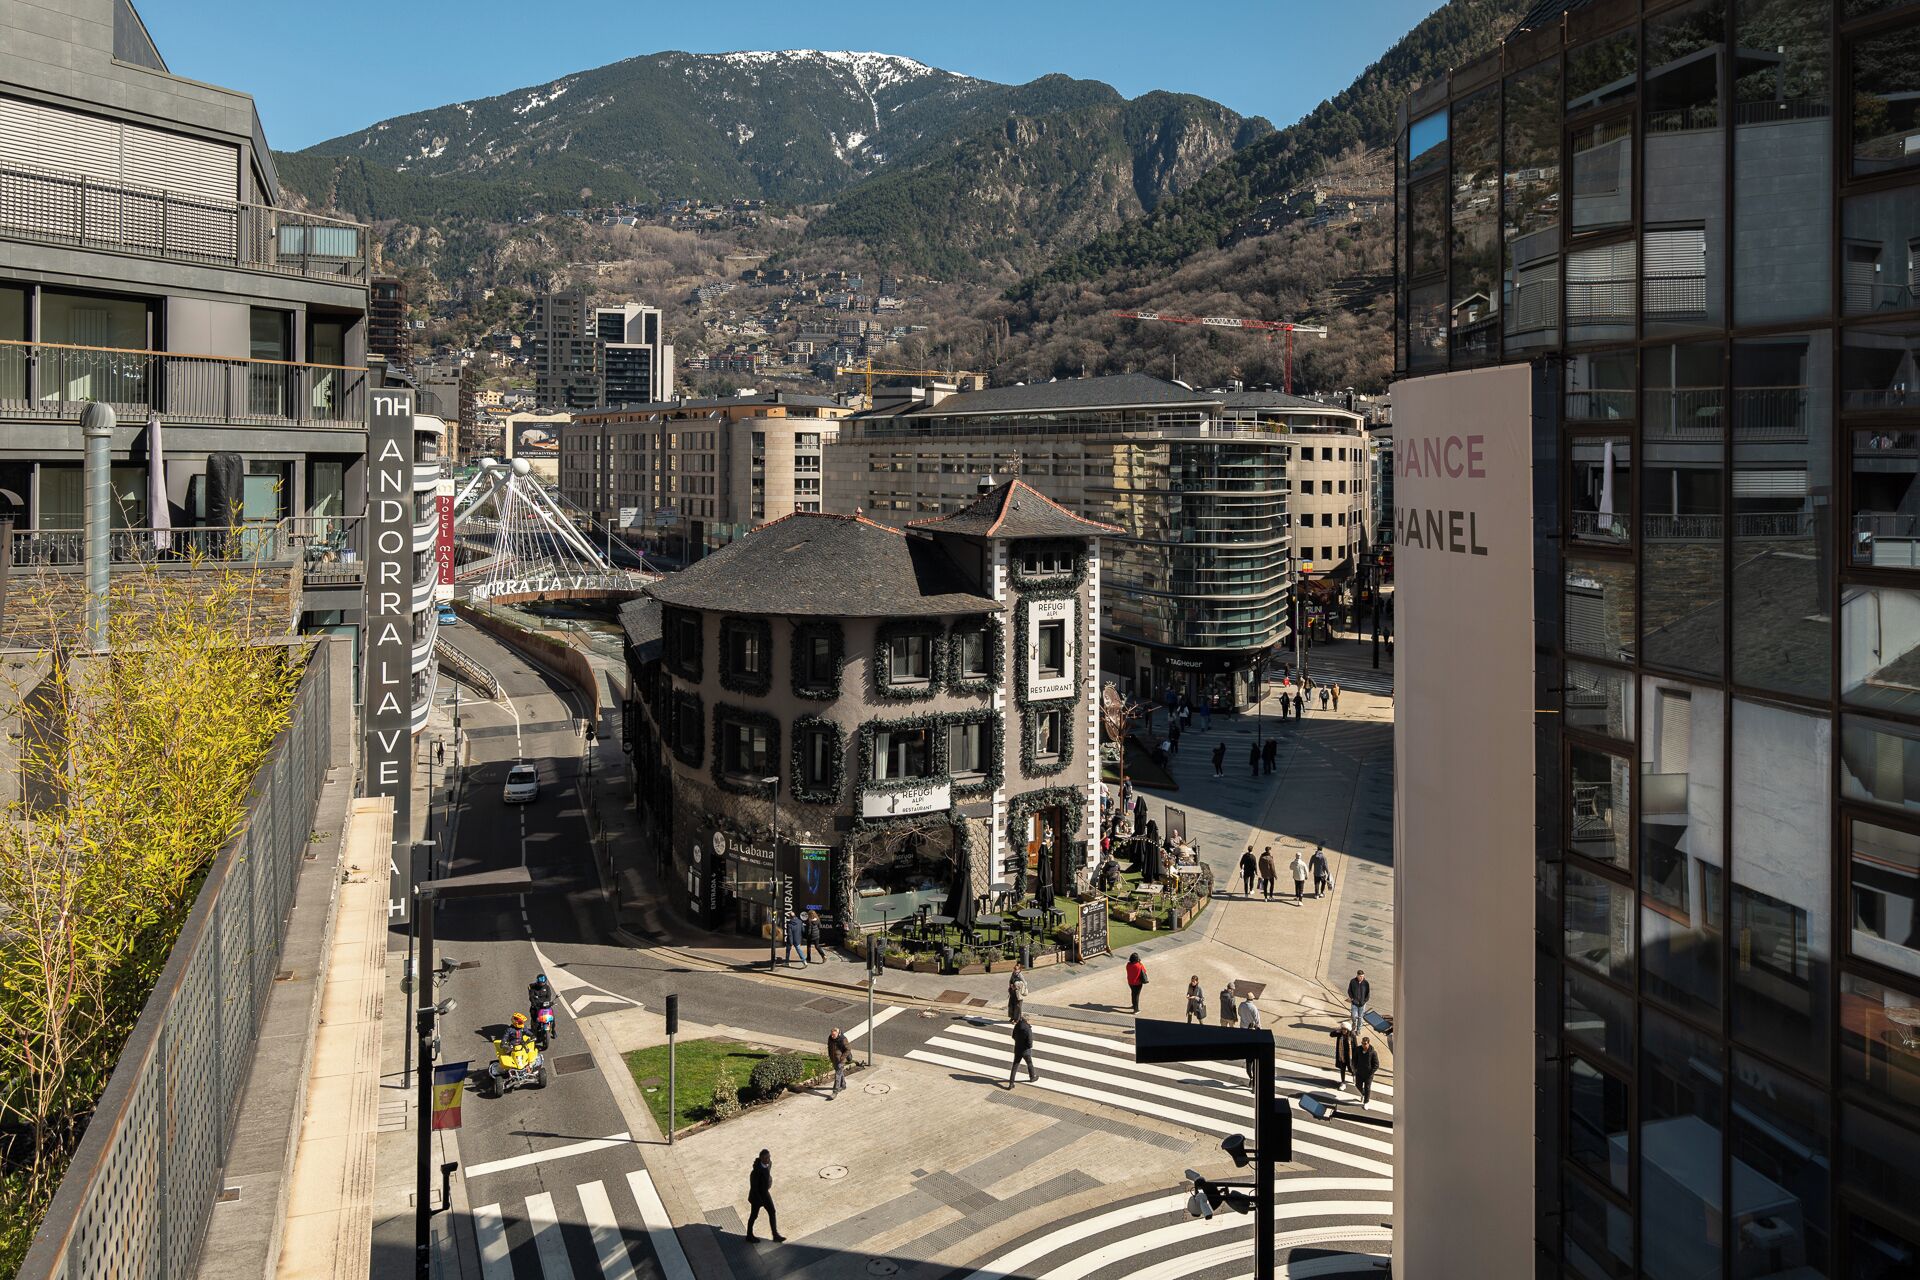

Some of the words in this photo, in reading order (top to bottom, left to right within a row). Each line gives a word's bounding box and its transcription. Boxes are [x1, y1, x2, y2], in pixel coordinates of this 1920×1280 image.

[1394, 435, 1486, 479] HANCE
[377, 438, 404, 646] ANDORRA
[537, 577, 563, 591] LA
[1038, 602, 1066, 612] REFUGI
[376, 661, 402, 716] LA
[1030, 683, 1072, 694] RESTAURANT
[902, 788, 933, 799] REFUGI
[902, 805, 932, 813] RESTAURANT
[729, 839, 739, 852] La
[740, 844, 774, 859] Cabana
